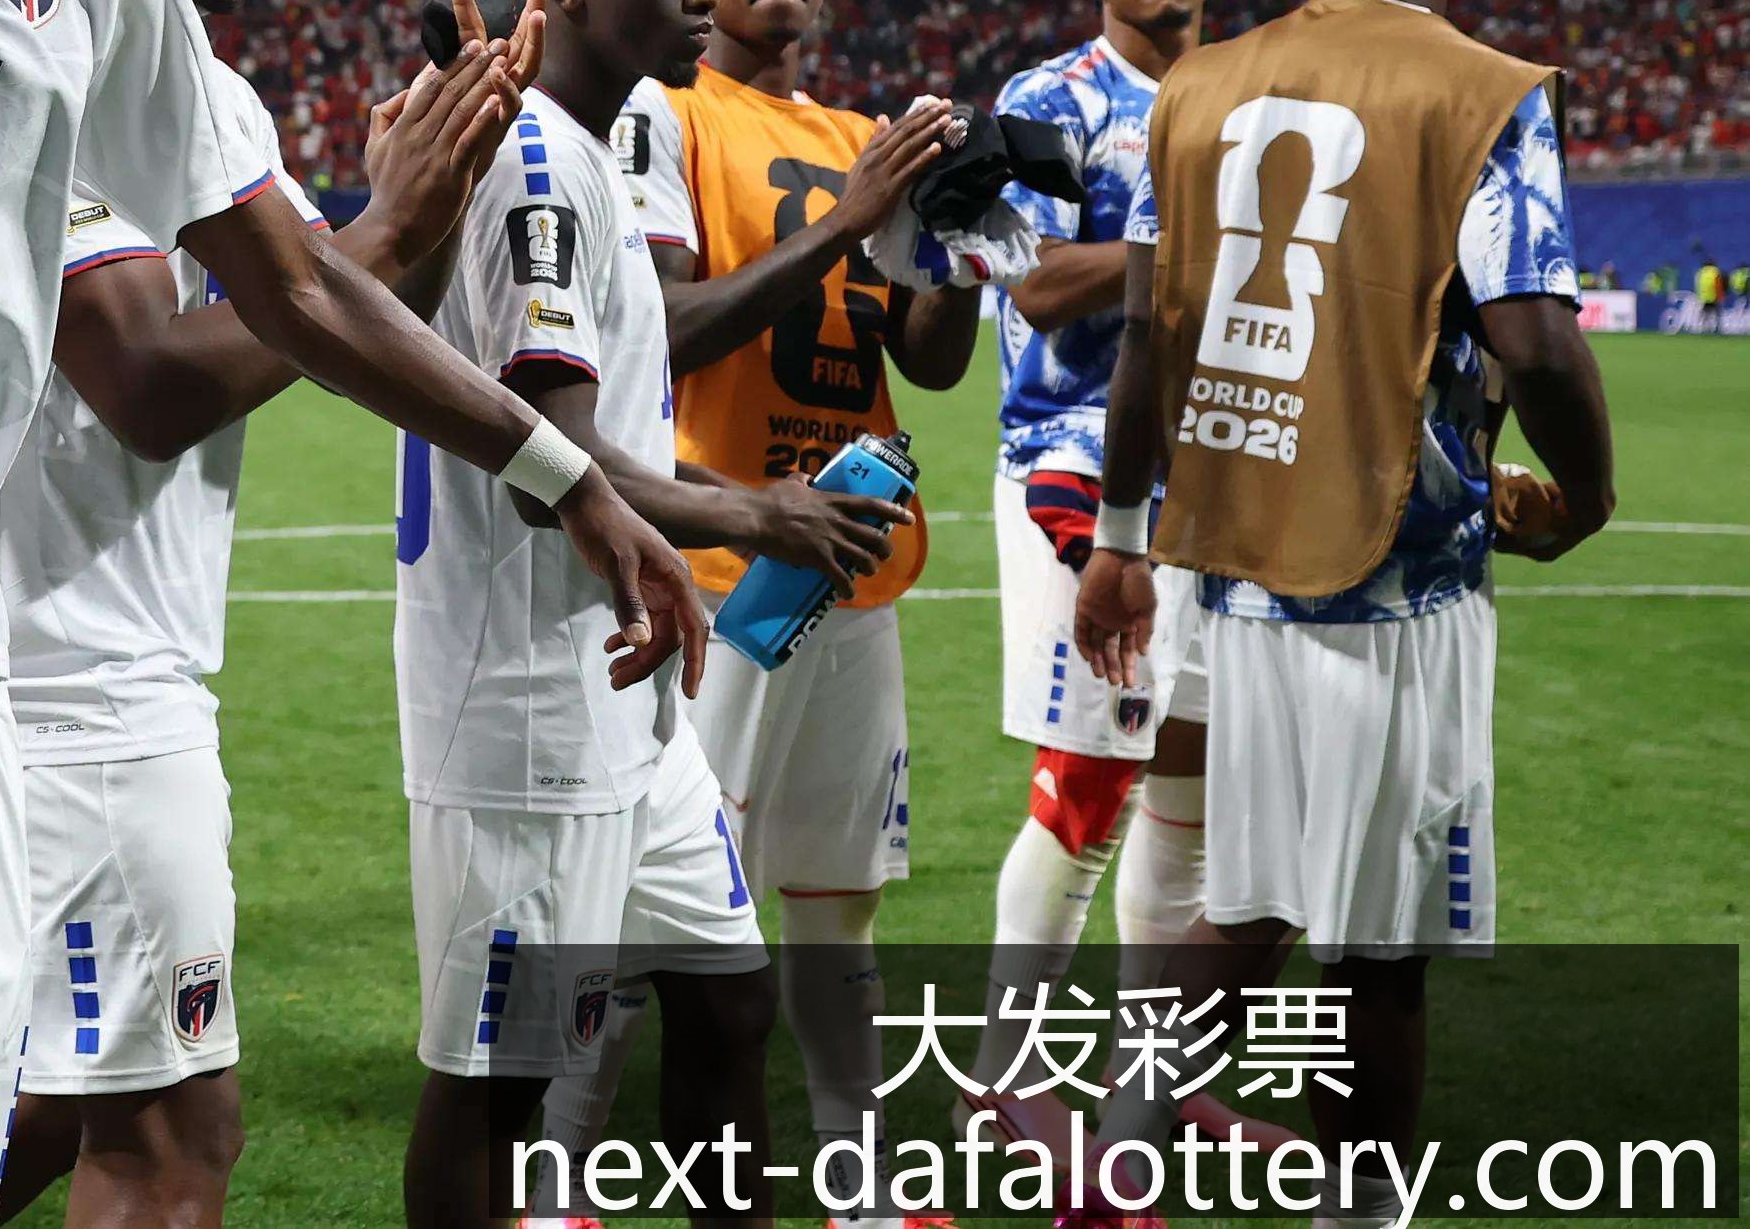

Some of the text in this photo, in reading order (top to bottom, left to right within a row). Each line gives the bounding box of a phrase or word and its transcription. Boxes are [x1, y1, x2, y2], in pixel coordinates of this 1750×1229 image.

[1224, 316, 1293, 353] FIFA
[812, 356, 863, 389] FIFA
[1188, 376, 1271, 412] ORLD
[768, 413, 848, 444] WORLD
[765, 443, 832, 479] 20
[850, 461, 871, 481] 21
[864, 436, 915, 477] POWERADE
[178, 960, 222, 982] FCF
[579, 973, 613, 989] FCF
